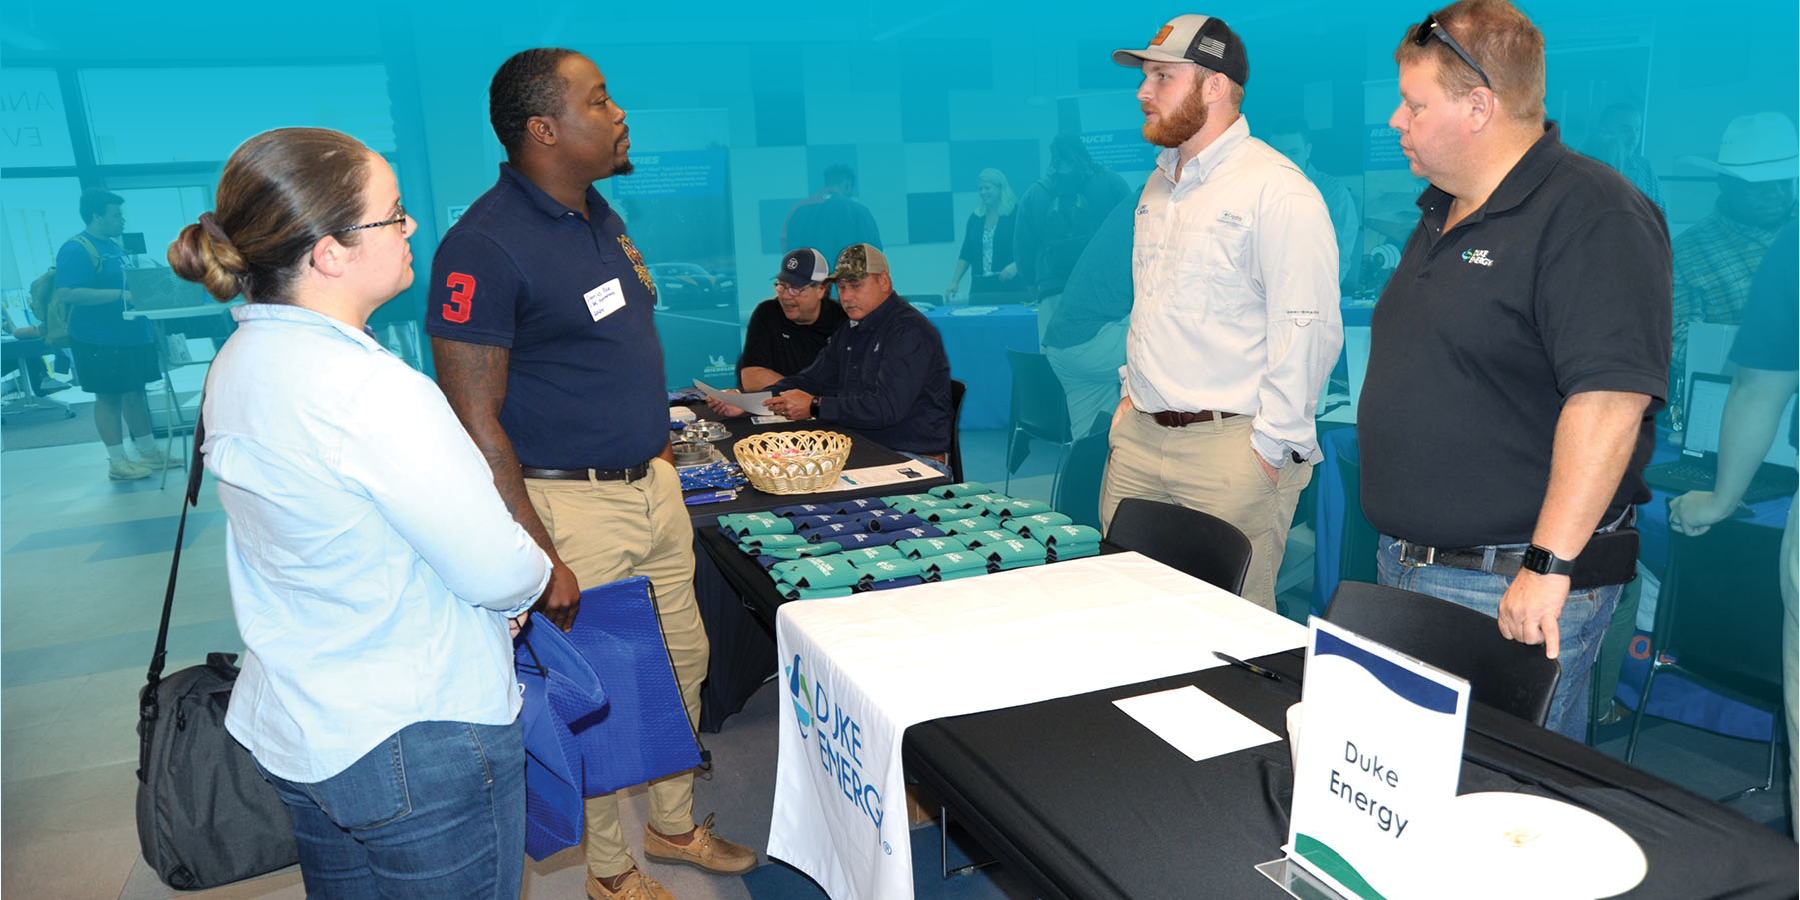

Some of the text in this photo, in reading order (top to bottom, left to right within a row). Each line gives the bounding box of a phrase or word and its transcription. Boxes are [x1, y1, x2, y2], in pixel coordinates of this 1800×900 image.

[1468, 256, 1494, 267] ENERGY
[1473, 249, 1489, 258] DUKE
[442, 272, 476, 324] 3
[1345, 740, 1399, 788] Duke
[1329, 769, 1409, 839] Energy
